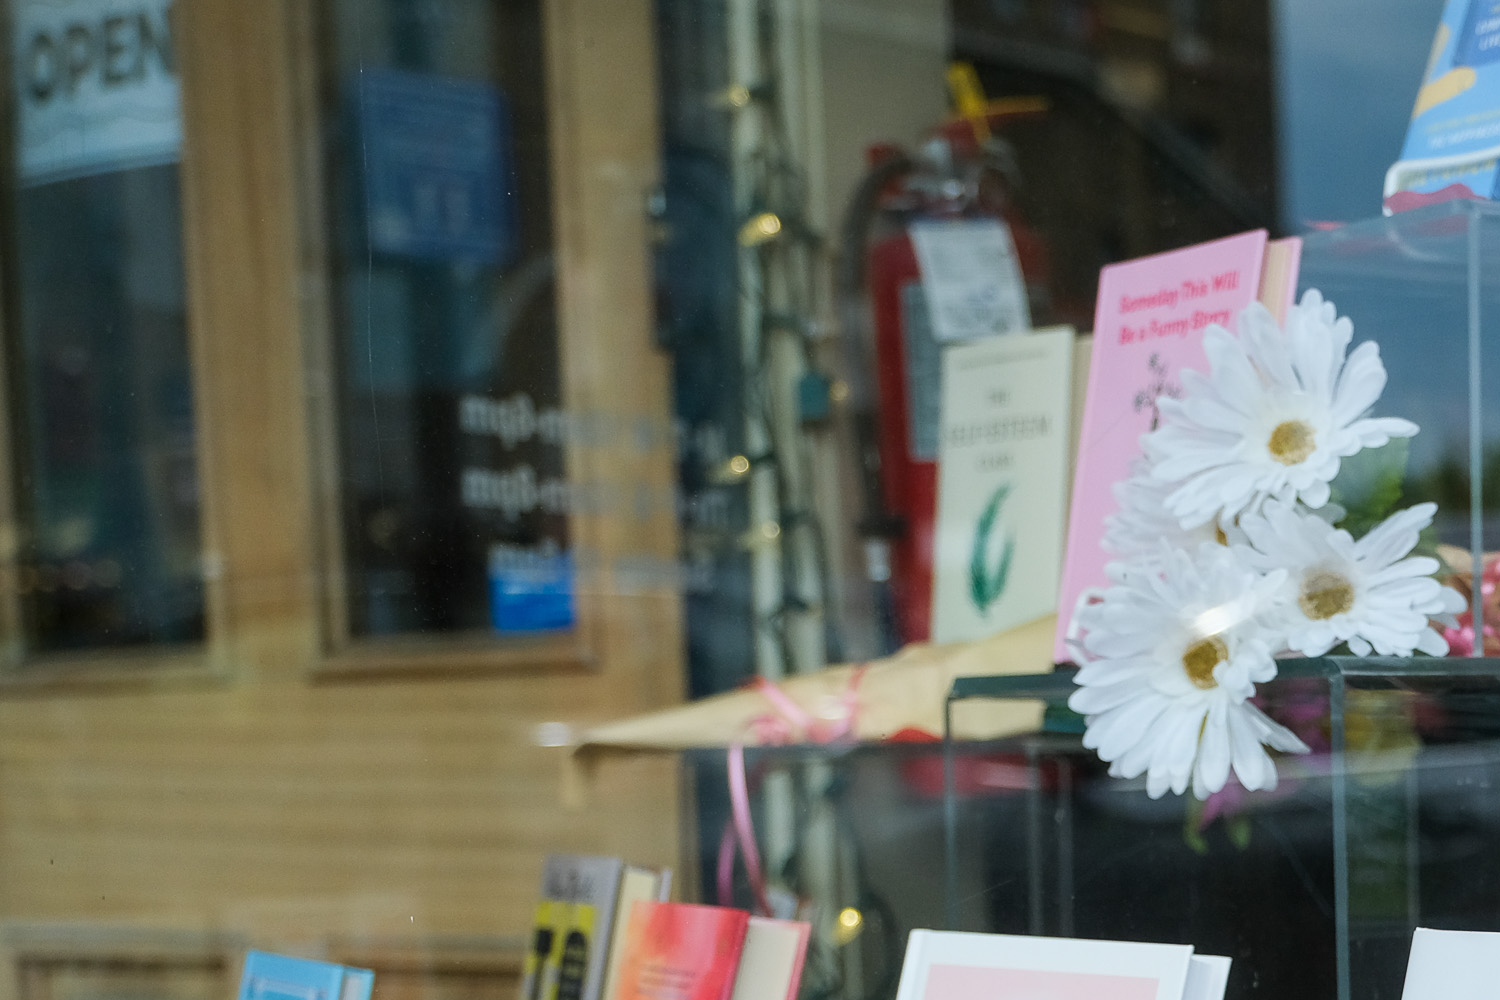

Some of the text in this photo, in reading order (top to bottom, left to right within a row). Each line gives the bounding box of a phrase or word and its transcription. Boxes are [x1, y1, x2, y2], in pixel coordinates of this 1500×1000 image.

[28, 10, 176, 105] OPEN
[1120, 270, 1240, 314] Someday This Will
[1119, 309, 1231, 345] Be a Funny Story
